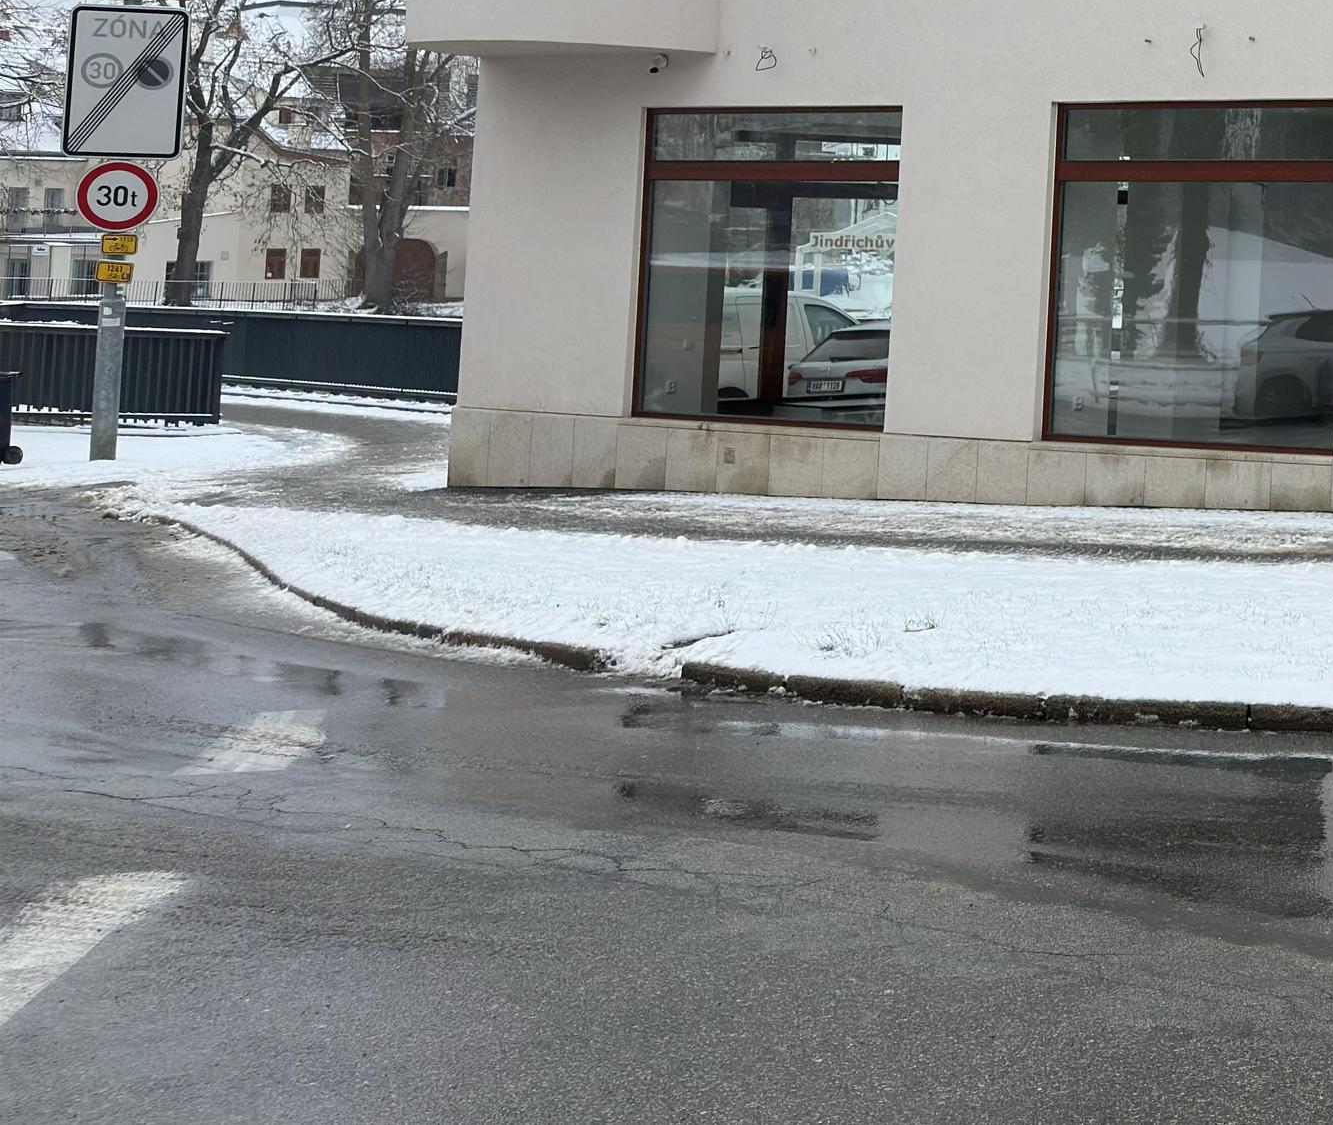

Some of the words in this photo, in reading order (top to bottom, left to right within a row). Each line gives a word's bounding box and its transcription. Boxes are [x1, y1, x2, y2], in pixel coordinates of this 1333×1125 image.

[92, 14, 168, 39] ZÓNA
[89, 61, 116, 79] 30
[811, 234, 895, 248] Jindřichův
